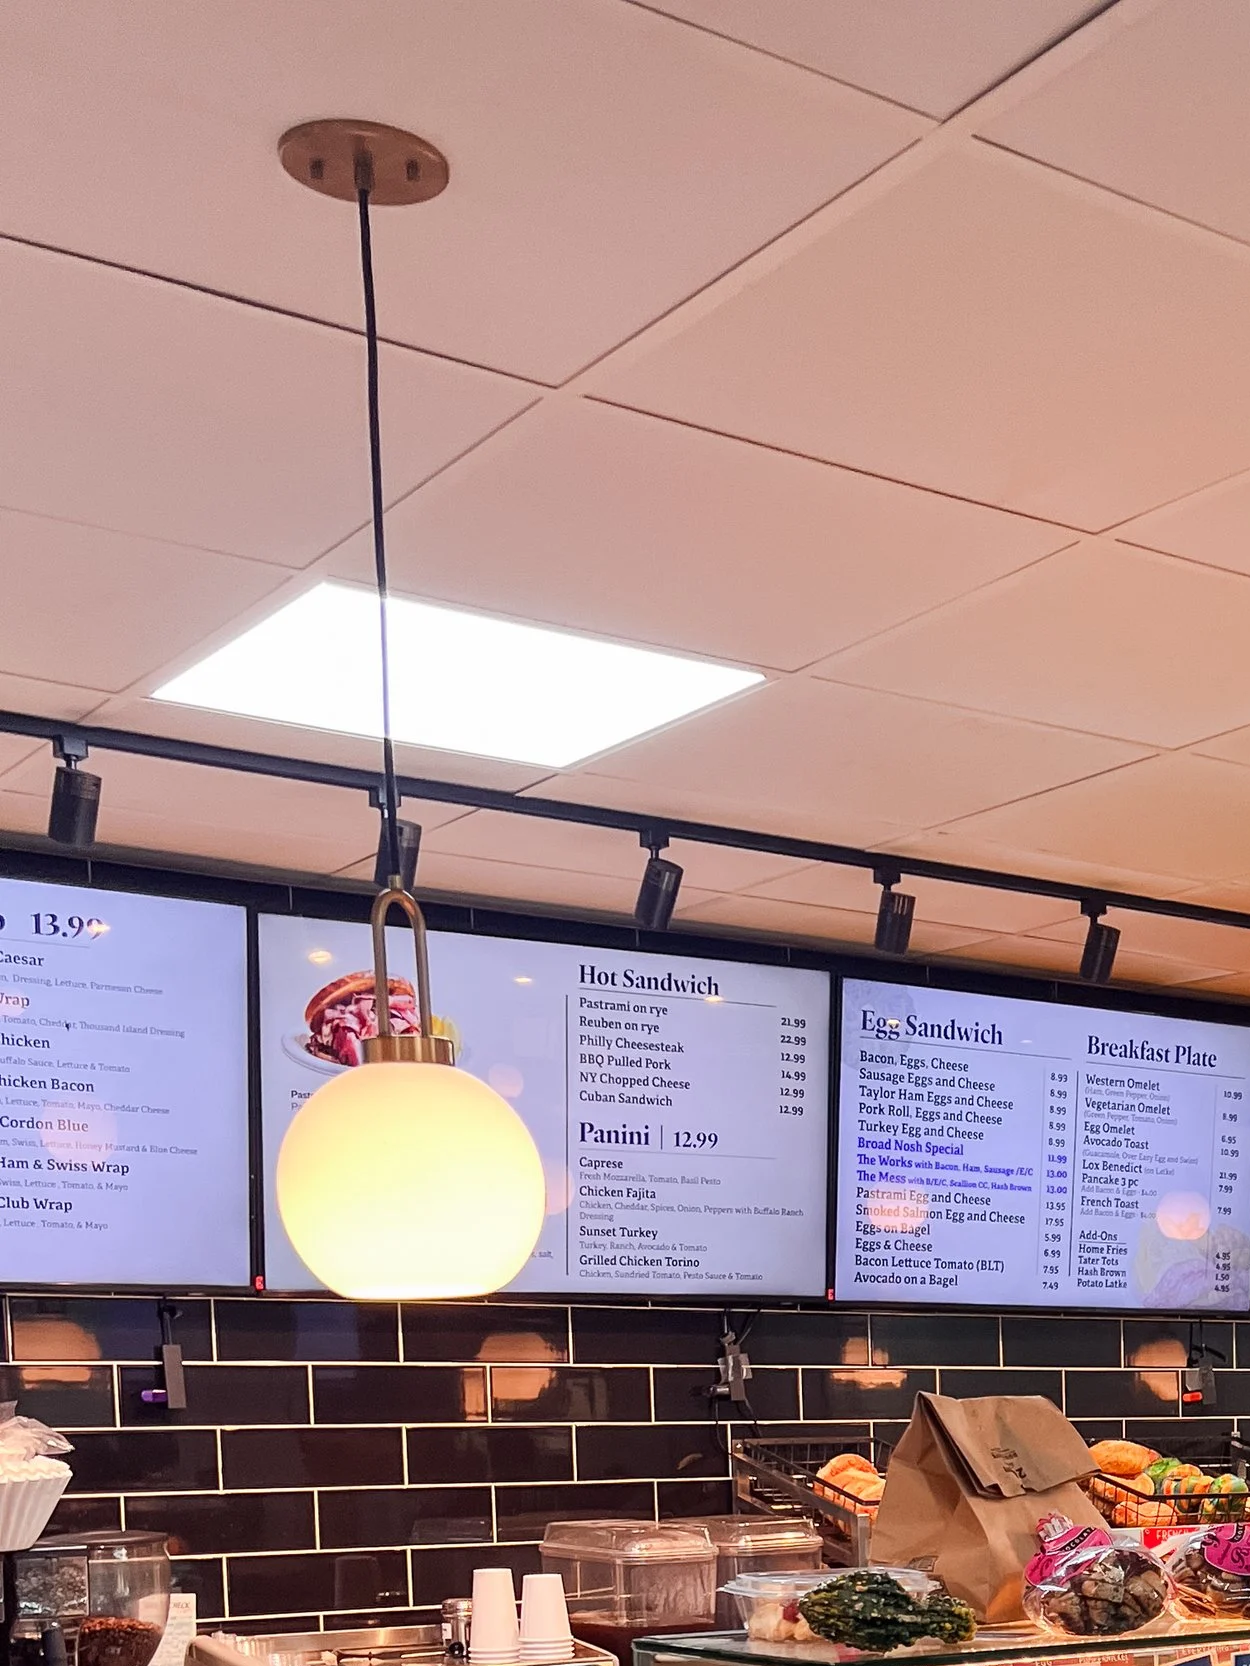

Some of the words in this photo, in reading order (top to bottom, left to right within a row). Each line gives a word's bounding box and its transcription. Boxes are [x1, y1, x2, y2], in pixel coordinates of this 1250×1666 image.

[578, 964, 618, 987] Hot
[622, 969, 720, 996] Sandwich
[579, 997, 631, 1012] Pastrami
[633, 1004, 647, 1013] on
[649, 1006, 668, 1018] rye
[579, 1015, 622, 1030] Reuben
[624, 1022, 638, 1031] on
[641, 1023, 660, 1035] rye
[781, 1018, 806, 1029] 21.99
[861, 1009, 901, 1040] Egg
[905, 1014, 1003, 1045] Sandwich
[579, 1034, 613, 1050] Philly
[615, 1037, 685, 1053] Cheesesteak
[780, 1035, 807, 1046] 22.99
[781, 1052, 806, 1064] 12.99
[1087, 1035, 1171, 1063] Breakfast
[1174, 1045, 1218, 1068] Plate
[579, 1053, 604, 1068] BBQ
[607, 1055, 643, 1069] Pulled
[645, 1058, 672, 1071] Pork
[860, 1050, 897, 1066] Bacon,
[899, 1054, 929, 1070] Eggs,
[931, 1057, 969, 1073] Cheese
[580, 1071, 597, 1084] NY
[599, 1073, 649, 1089] Chopped
[651, 1076, 691, 1090] Cheese
[781, 1070, 806, 1081] 14.99
[859, 1067, 905, 1086] Sausage
[907, 1072, 933, 1088] Eggs
[935, 1076, 955, 1088] and
[957, 1077, 996, 1092] Cheese
[1086, 1074, 1125, 1088] Western
[1127, 1078, 1161, 1091] Omelet
[51, 1078, 94, 1092] Bacon
[780, 1087, 805, 1099] 12.99
[579, 1090, 616, 1103] Cuban
[618, 1092, 673, 1107] Sandwich
[1085, 1097, 1136, 1113] Vegetarian
[1137, 1102, 1171, 1116] Omelet
[779, 1105, 804, 1116] 12.99
[57, 1119, 89, 1133] Blue
[857, 1119, 899, 1136] Turkey
[901, 1123, 922, 1139] Egg
[923, 1125, 944, 1137] and
[946, 1126, 984, 1141] Cheese
[579, 1121, 650, 1146] Panini
[673, 1131, 719, 1149] 12.99
[857, 1136, 892, 1151] Broad
[894, 1139, 923, 1153] Nosh
[925, 1141, 965, 1156] Special
[33, 1159, 43, 1170] &
[47, 1158, 88, 1172] Swiss
[91, 1161, 130, 1176] Wrap
[579, 1156, 624, 1171] Caprese
[579, 1185, 623, 1199] Chicken
[626, 1187, 657, 1201] Fajita
[33, 1197, 73, 1213] Wrap
[1081, 1196, 1112, 1208] French
[1114, 1198, 1140, 1209] Toast
[579, 1225, 617, 1238] Sunset
[619, 1227, 659, 1241] Turkey
[1078, 1243, 1105, 1254] Home
[1106, 1245, 1128, 1256] Fries
[579, 1254, 617, 1267] Grilled
[619, 1255, 662, 1268] Chicken
[664, 1256, 700, 1268] Torino
[855, 1254, 889, 1267] Bacon
[891, 1256, 932, 1269] Lettuce
[933, 1258, 974, 1271] Tomato
[976, 1259, 1005, 1273] (BLT)
